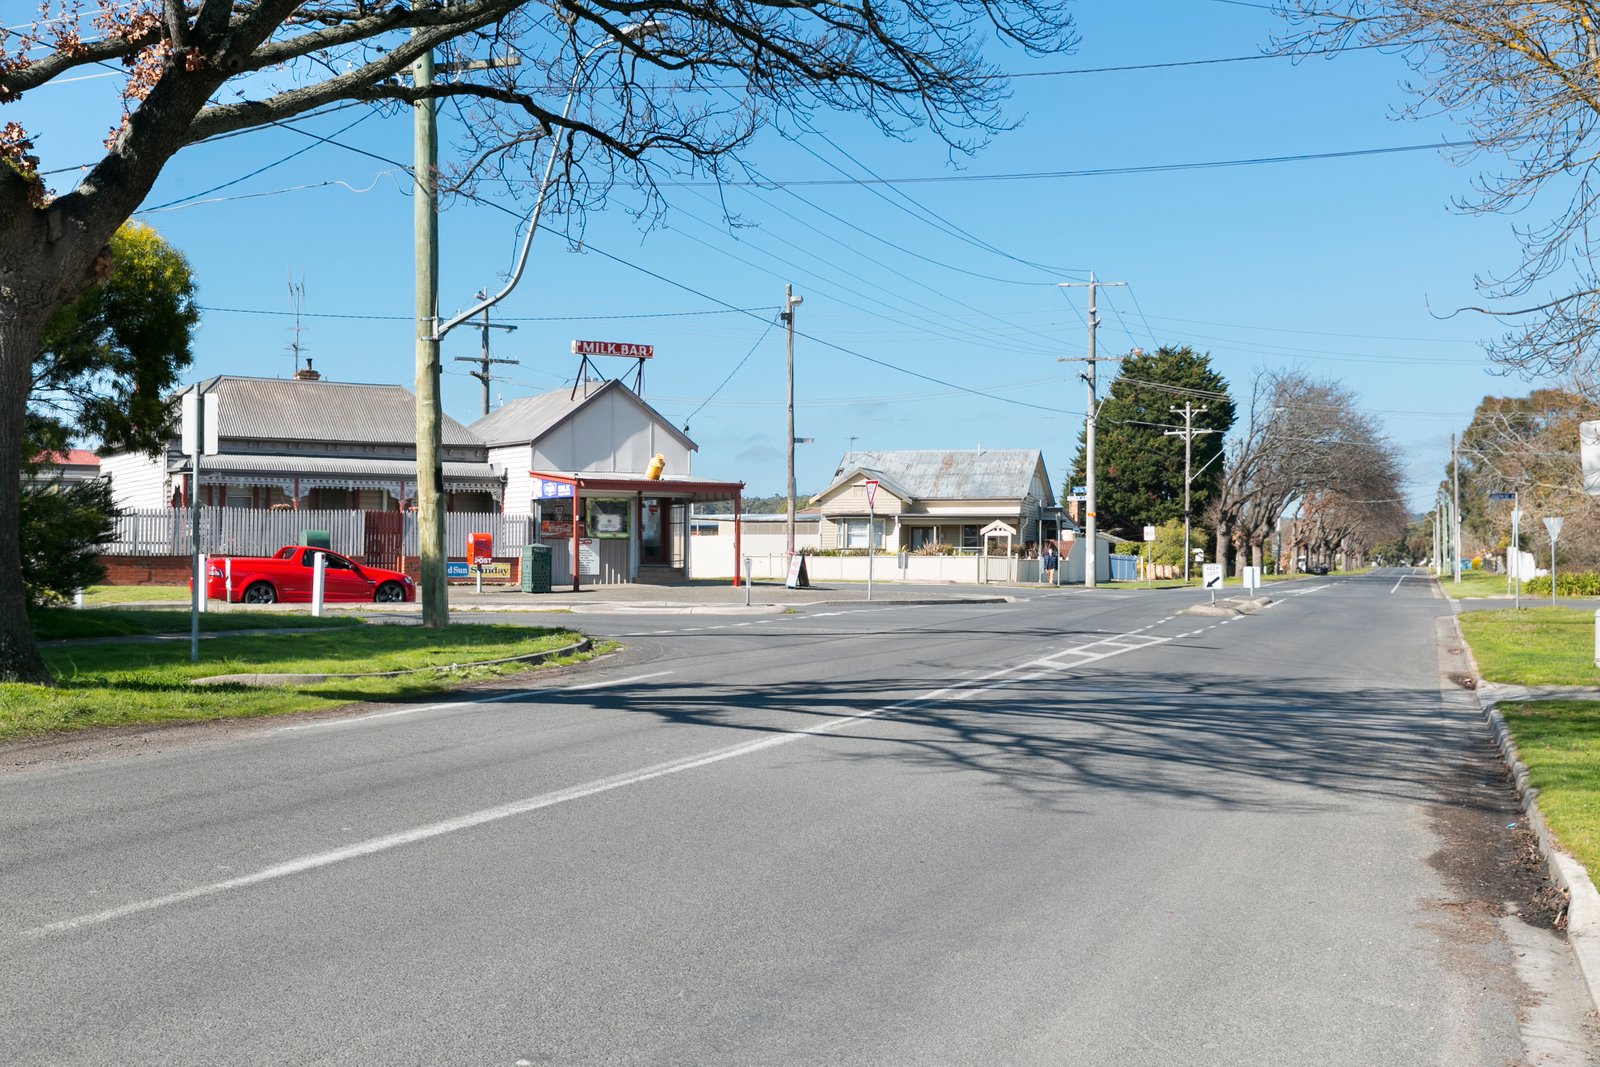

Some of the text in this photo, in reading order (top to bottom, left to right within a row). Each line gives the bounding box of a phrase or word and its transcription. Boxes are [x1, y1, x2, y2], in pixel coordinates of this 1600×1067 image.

[582, 341, 647, 356] MILK BAR
[453, 566, 468, 574] Sun
[470, 566, 509, 576] Snday
